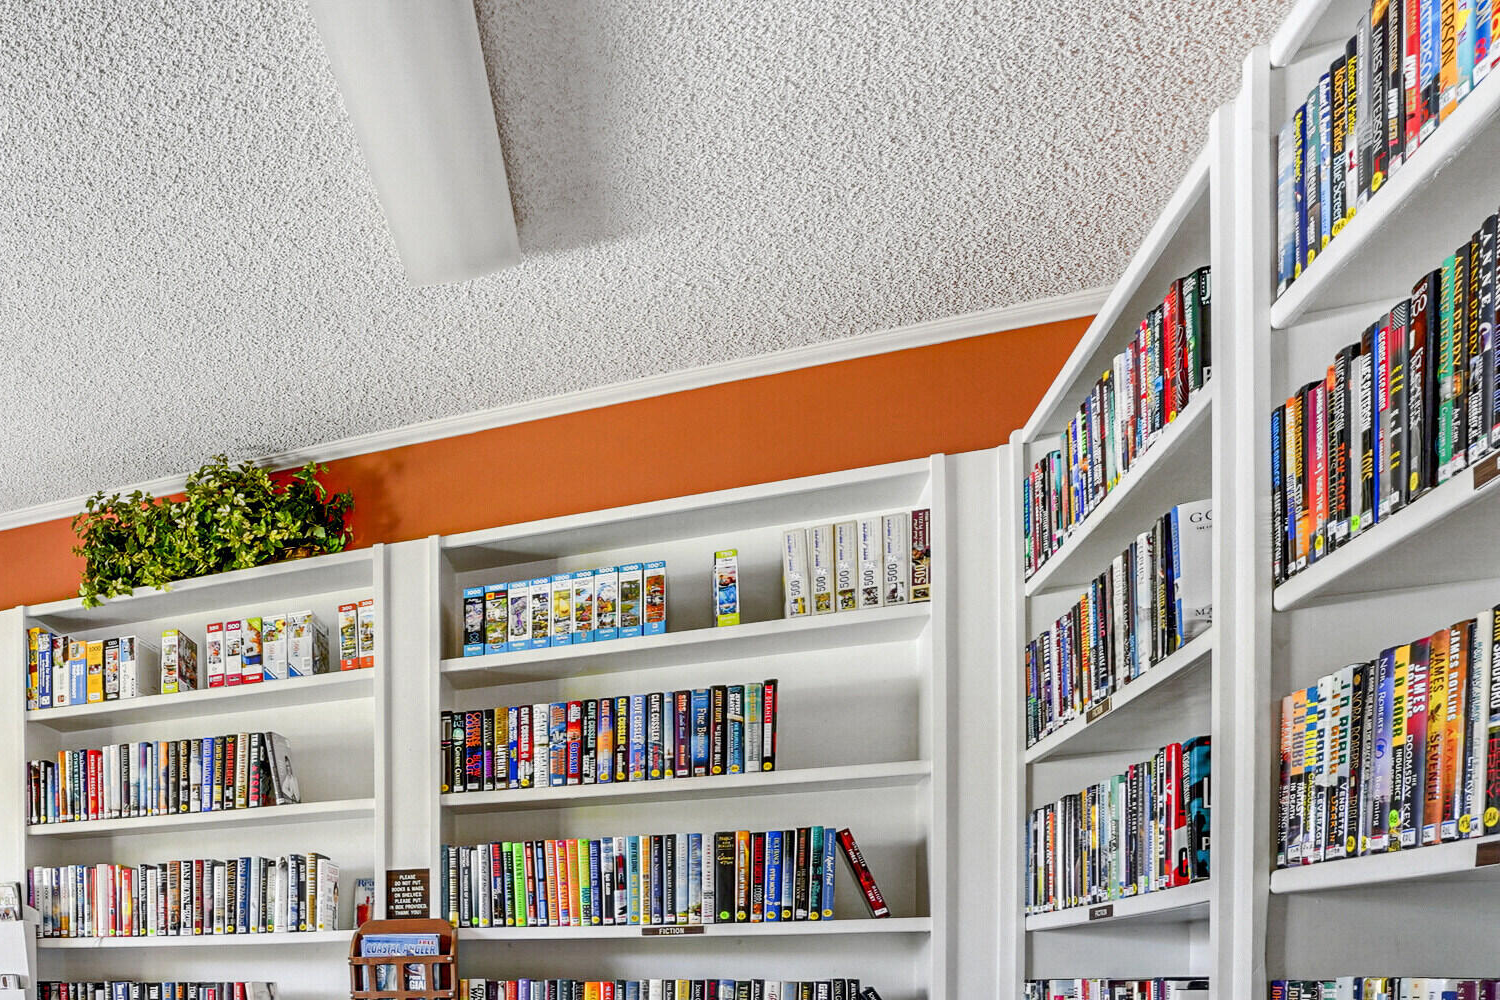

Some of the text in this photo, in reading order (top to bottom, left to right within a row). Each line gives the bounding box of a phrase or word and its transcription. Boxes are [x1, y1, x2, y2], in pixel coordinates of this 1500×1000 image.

[1334, 66, 1346, 107] Robert
[1372, 27, 1382, 154] JAMES PATTERSON
[1334, 120, 1345, 154] Parker
[1333, 154, 1344, 222] Blue Screen
[790, 580, 801, 596] 500
[816, 576, 826, 592] 500
[839, 570, 849, 588] 500
[864, 570, 874, 586] 500
[888, 563, 898, 581] 500
[914, 564, 926, 584] 500
[1412, 664, 1426, 713] JAMES
[1433, 651, 1444, 692] JAMES
[1447, 630, 1460, 722] JAMES ROLLINS
[634, 696, 643, 714] CLIVE
[1352, 690, 1362, 723] NORA
[1377, 658, 1388, 734] NORA ROBERTS
[651, 694, 660, 741] CLIVE CUSSLER
[570, 742, 579, 774] CORSAIR
[1351, 726, 1360, 770] ROBERTS
[466, 757, 474, 775] OUT
[473, 754, 481, 777] BLOW
[1395, 748, 1403, 801] INDULGENCE
[1404, 734, 1414, 828] DOOMSDAY KEY
[1428, 734, 1441, 801] SEVENTH
[1296, 782, 1304, 816] FANTASY
[1373, 776, 1383, 826] Becoming
[1315, 792, 1324, 846] LEVERAGE
[366, 943, 436, 954] COASTAL ANGLER
[150, 986, 159, 1000] TOM
